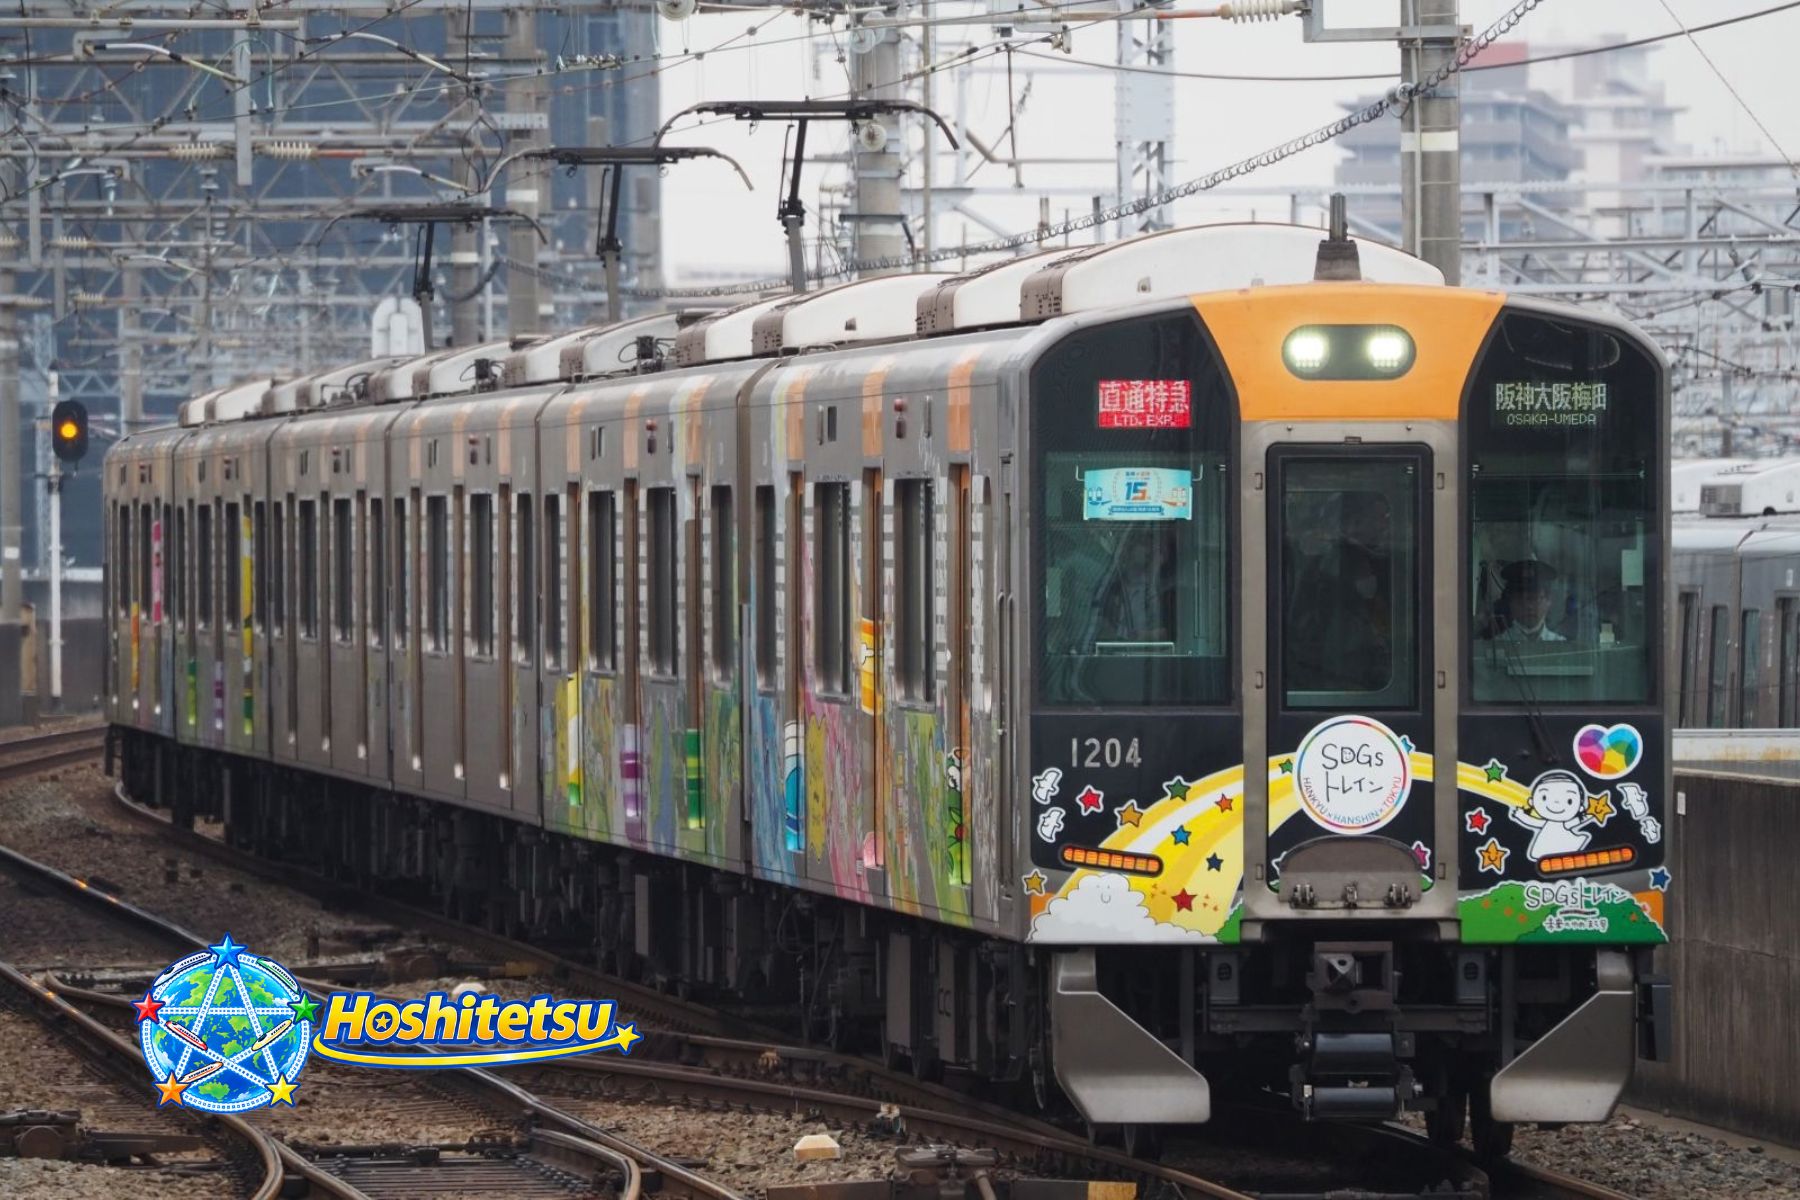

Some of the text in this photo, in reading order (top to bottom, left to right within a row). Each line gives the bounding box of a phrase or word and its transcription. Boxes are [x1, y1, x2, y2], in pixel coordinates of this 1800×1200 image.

[1099, 380, 1189, 413] 直通特急
[1496, 383, 1607, 410] 阪神大阪梅田
[1114, 414, 1175, 426] LTD. EXP.
[1507, 413, 1597, 425] OSAKA-UMEDA
[1126, 482, 1147, 500] 15
[1072, 738, 1142, 767] 1204
[1321, 743, 1384, 770] SDGs
[1303, 777, 1328, 814] HANKYU
[1333, 811, 1379, 824] HANSHIN
[1383, 776, 1401, 807] TOKYU
[1325, 771, 1384, 803] トレイン
